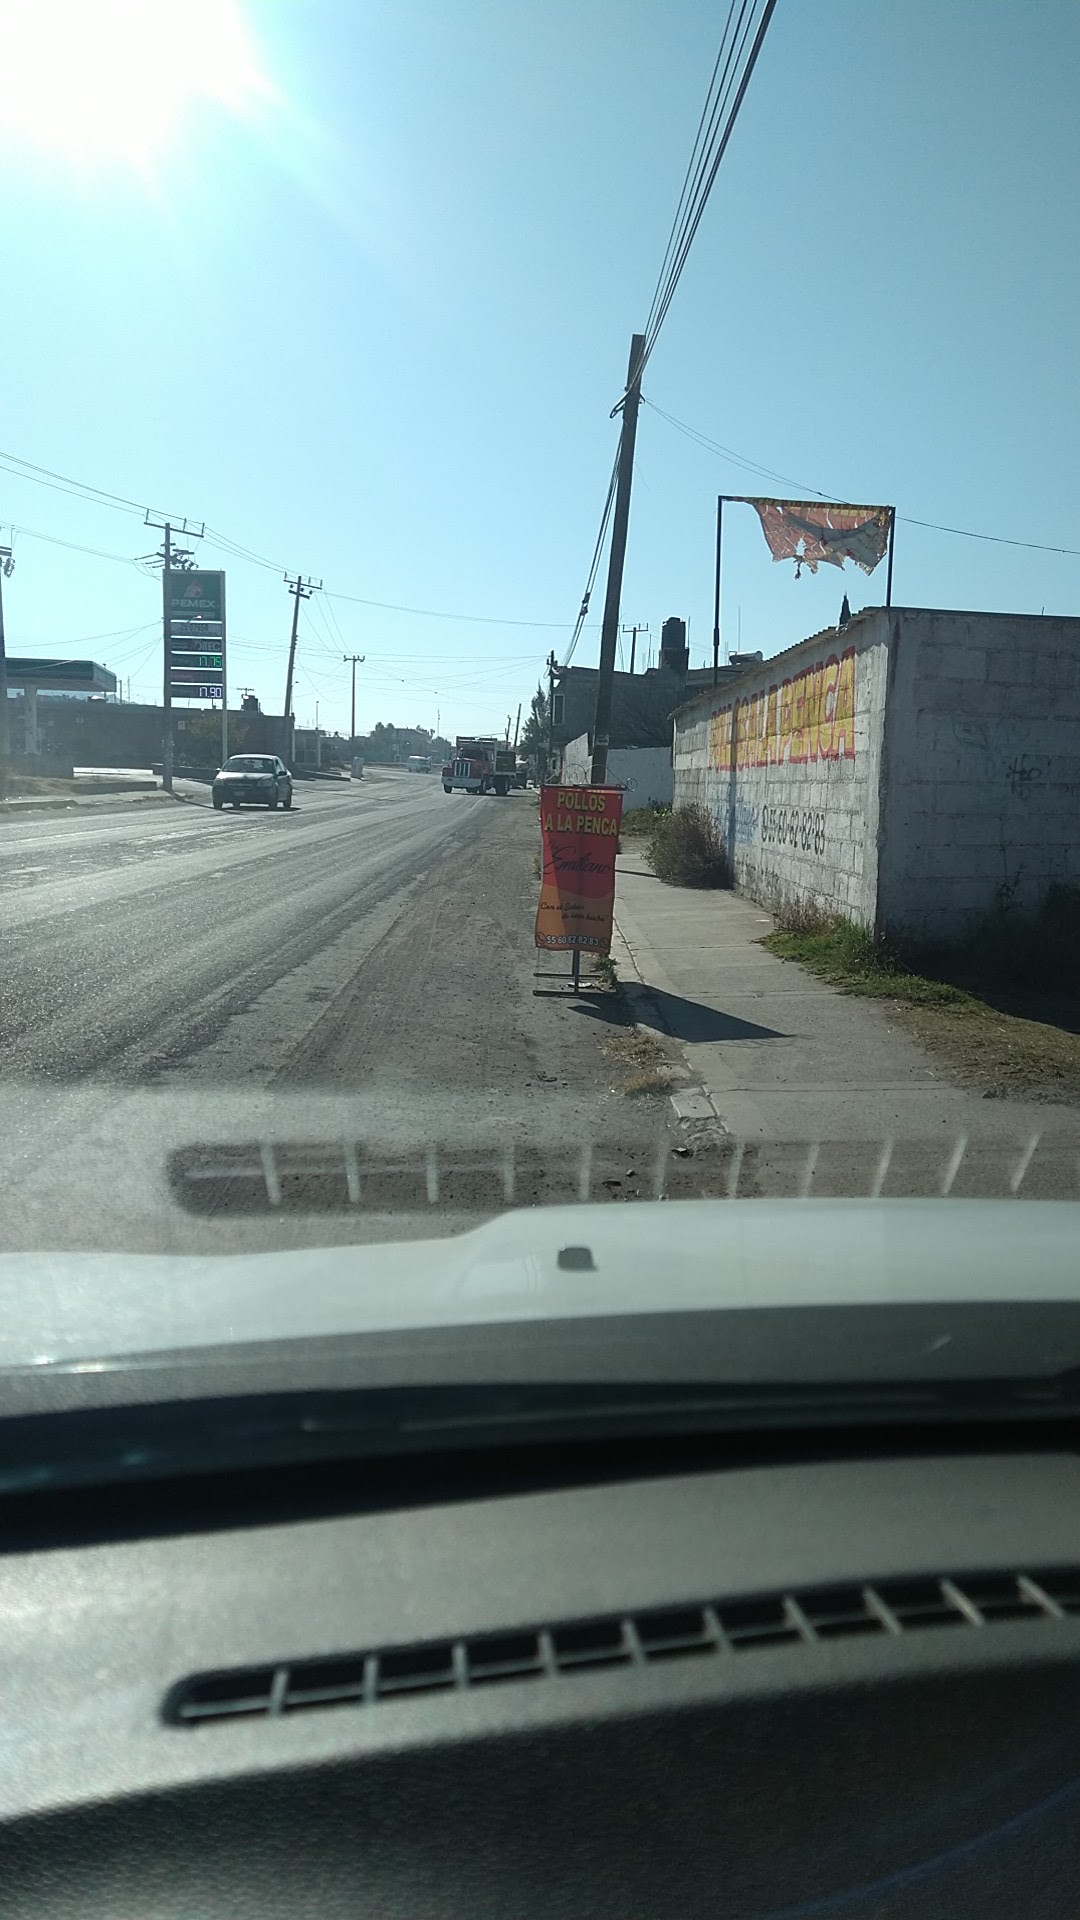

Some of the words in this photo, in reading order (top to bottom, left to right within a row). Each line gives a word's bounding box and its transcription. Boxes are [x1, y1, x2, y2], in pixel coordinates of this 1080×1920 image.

[171, 599, 215, 608] PEMEX
[199, 656, 222, 668] 17.75
[199, 687, 222, 698] 17.90
[778, 645, 856, 766] PENCA
[557, 791, 605, 812] POLLOS
[544, 813, 553, 831] A
[557, 814, 572, 832] LA
[576, 815, 617, 835] PENCA
[547, 935, 557, 944] 55
[558, 936, 567, 944] 60
